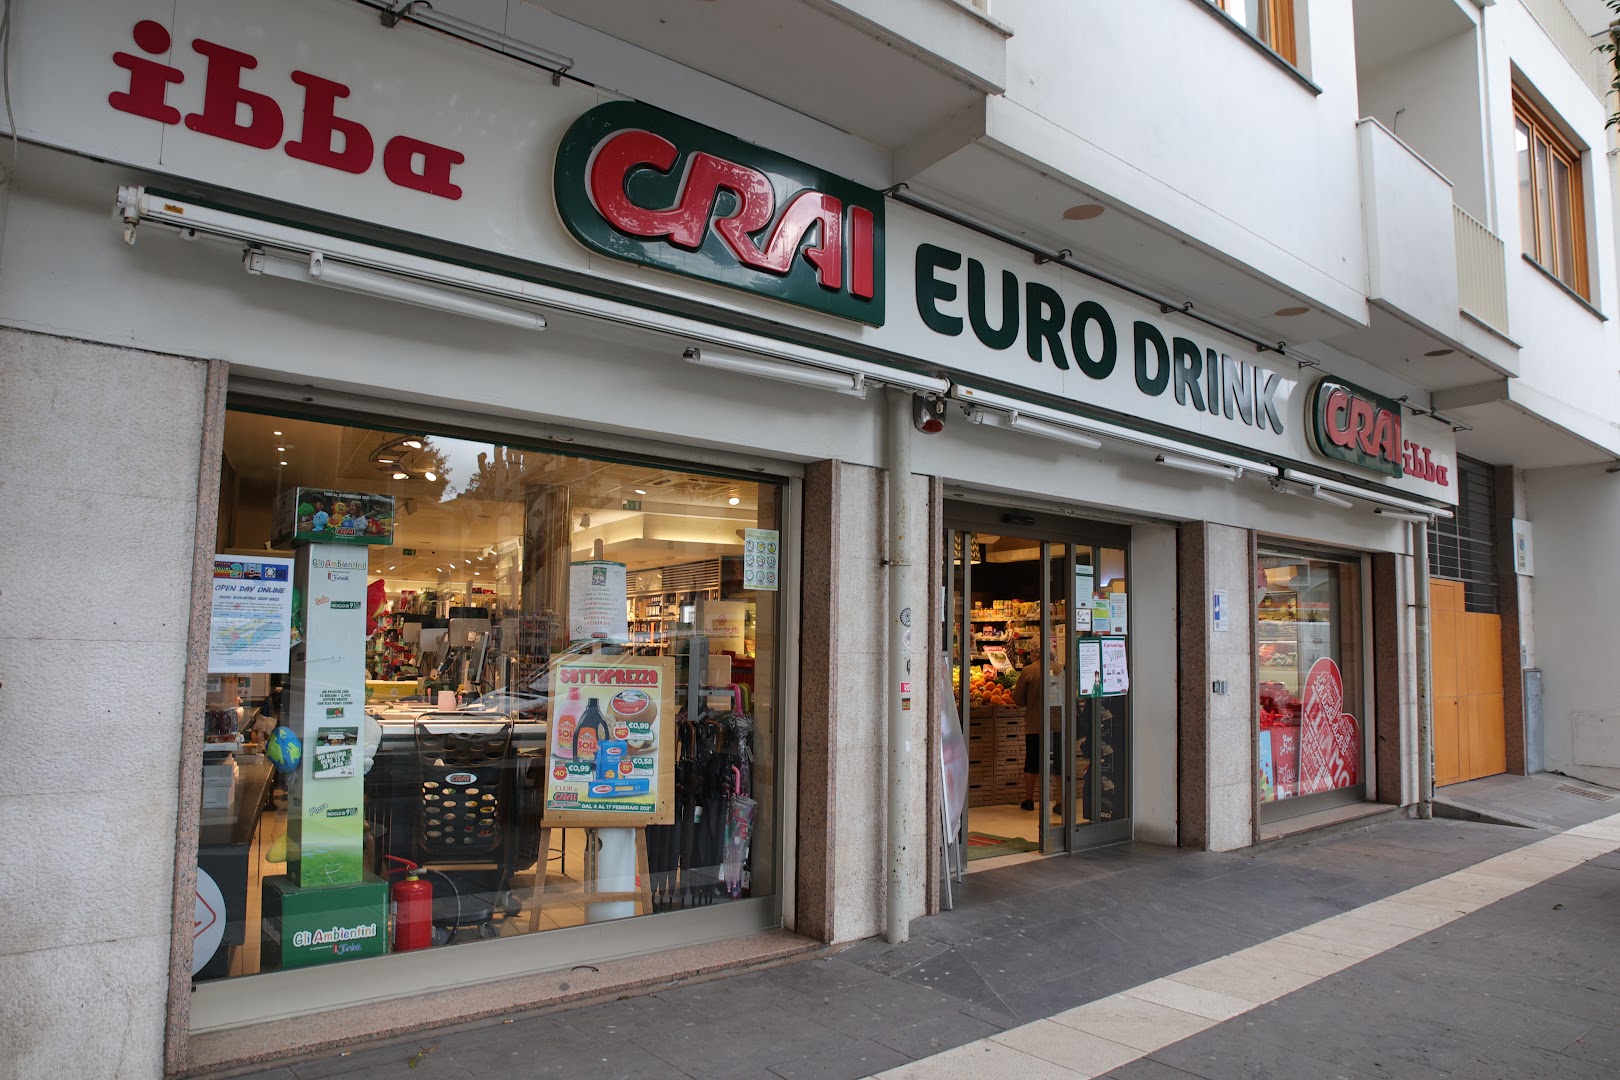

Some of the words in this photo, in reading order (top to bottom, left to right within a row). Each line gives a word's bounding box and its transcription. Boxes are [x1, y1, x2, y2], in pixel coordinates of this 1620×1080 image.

[108, 20, 465, 201] ibba
[588, 128, 875, 300] CRAI
[915, 243, 1117, 380] EURO
[1133, 320, 1284, 436] DRINK
[1324, 387, 1402, 466] CRAI
[1402, 439, 1449, 487] ibba
[215, 584, 236, 592] OPEN
[239, 585, 255, 593] DAY
[257, 586, 286, 594] ONLINE
[560, 669, 658, 685] SOTTOPREZZO
[628, 722, 649, 730] €0,99
[326, 751, 347, 759] BOLLINO
[329, 760, 344, 768] SPESA
[632, 757, 653, 765] €0,58
[293, 930, 312, 947] Gli
[312, 923, 377, 944] Ambientini
